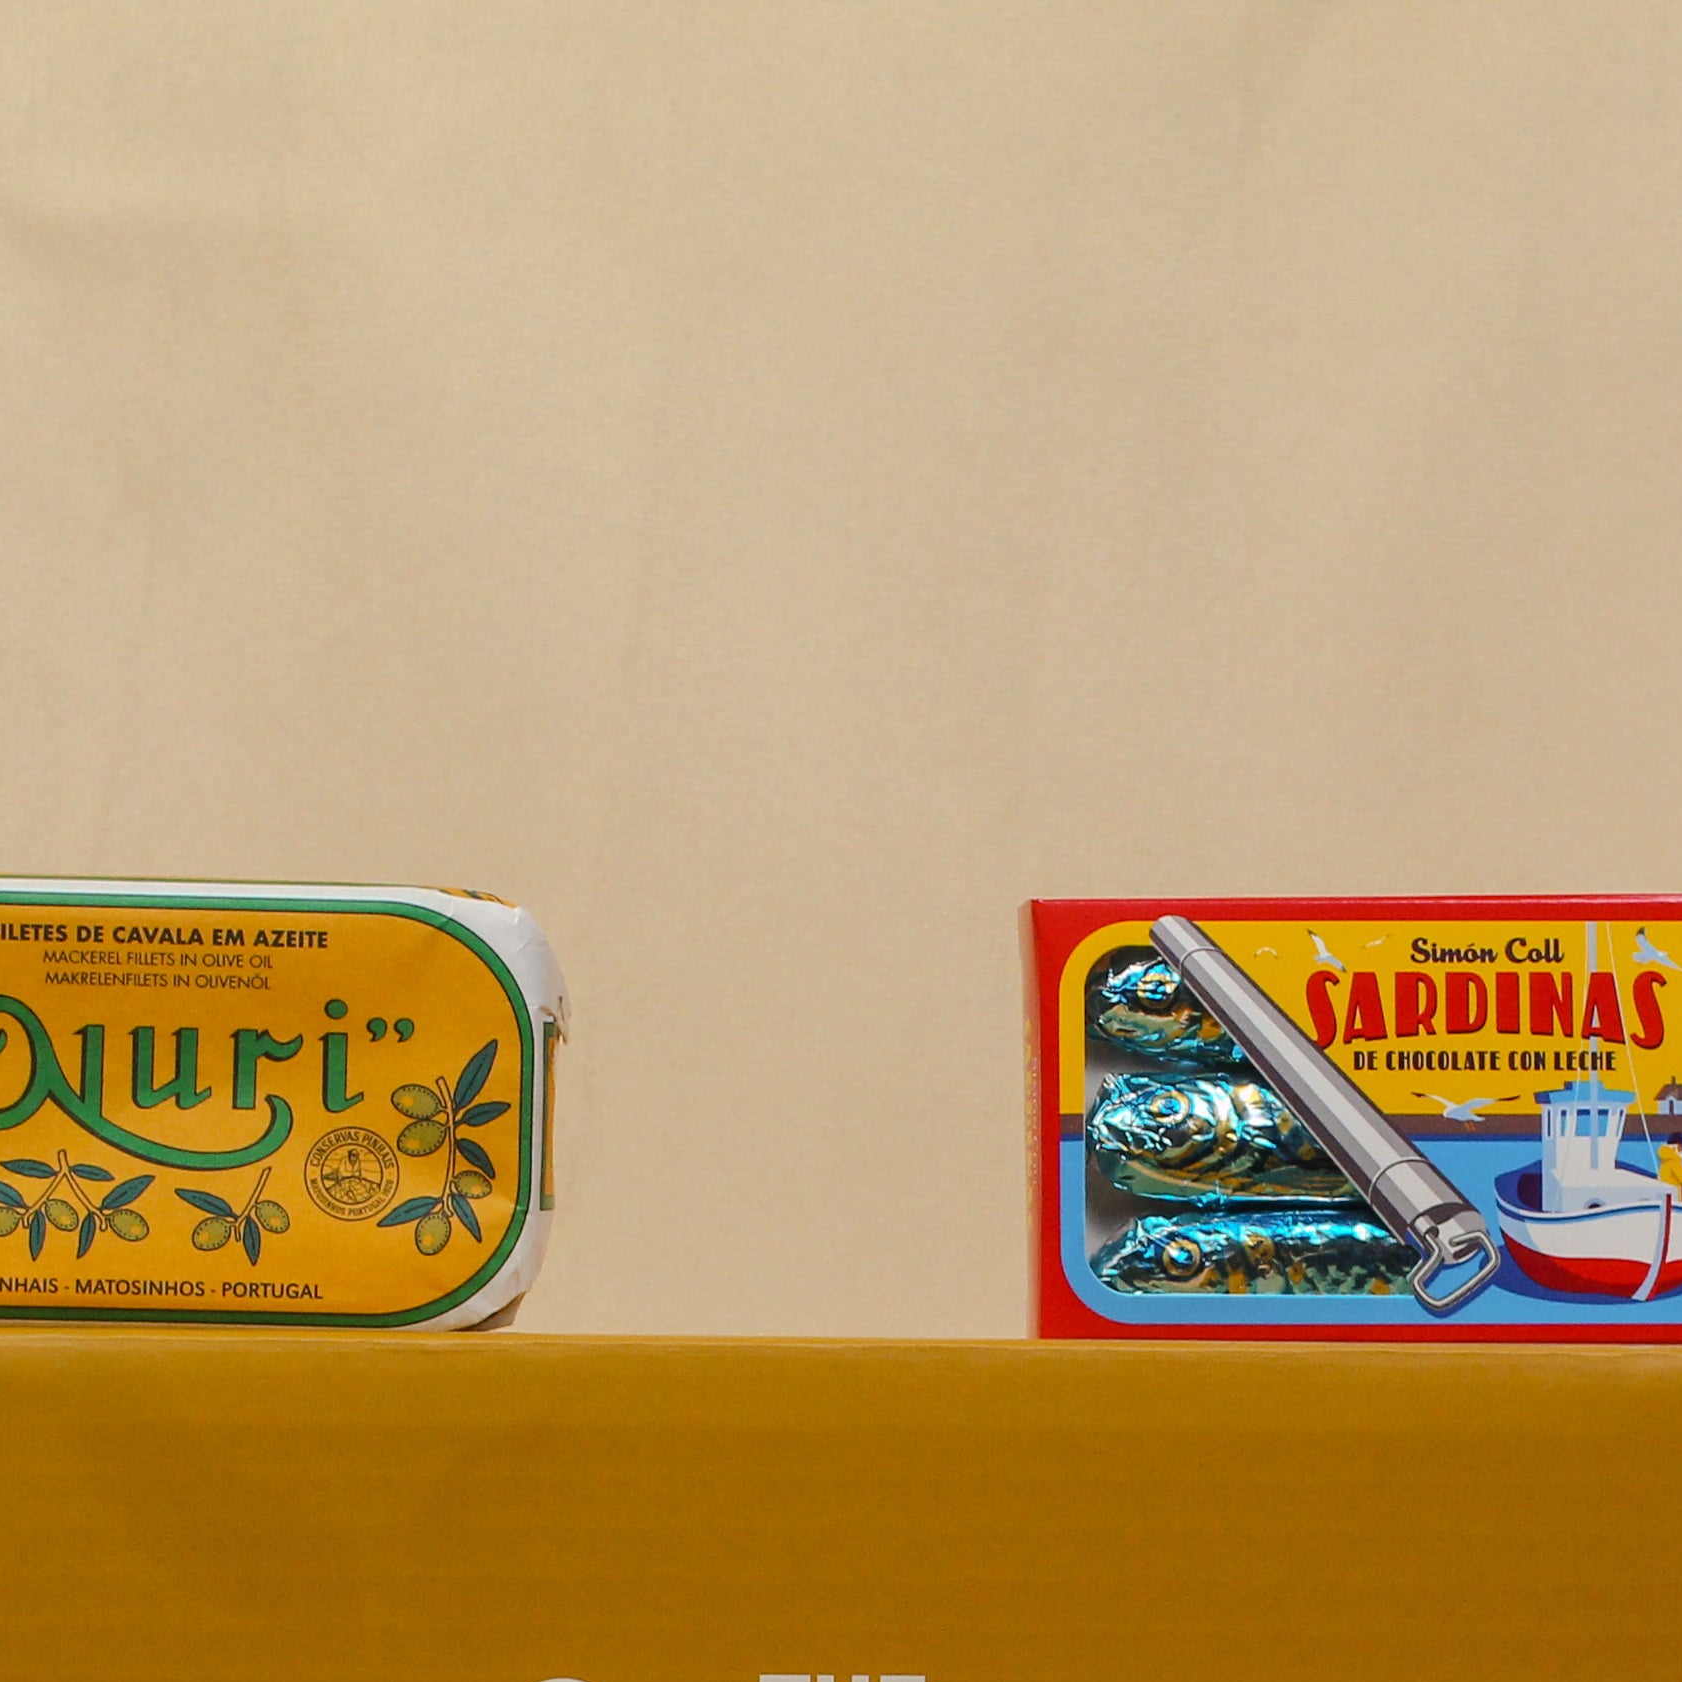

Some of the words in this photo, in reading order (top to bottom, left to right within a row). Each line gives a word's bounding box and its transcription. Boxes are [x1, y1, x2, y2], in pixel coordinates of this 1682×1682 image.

[76, 926, 104, 943] DE
[113, 926, 205, 945] CAVALA
[212, 929, 245, 946] EM
[253, 930, 329, 948] AZEITE
[42, 950, 122, 965] MACKEREL
[126, 951, 175, 966] FILLETS
[180, 952, 197, 967] IN
[202, 953, 244, 968] OLIVE
[249, 954, 273, 969] OIL
[1410, 936, 1498, 964] Simón
[1504, 937, 1565, 964] Coll
[44, 971, 168, 987] MAKRELENFILETS
[173, 973, 190, 988] IN
[195, 972, 271, 990] OLIVENÖL
[1305, 969, 1668, 1050] SARDINAS
[1353, 1050, 1379, 1071] DE
[1386, 1050, 1501, 1071] CHOCOLATE
[1508, 1051, 1547, 1071] CON
[1554, 1051, 1617, 1071] LECHE
[310, 1131, 360, 1167] CONSERVAS
[362, 1133, 395, 1169] PINHAIS
[74, 1278, 205, 1297] MATOSINHOS
[222, 1281, 323, 1300] PORTUGAL
